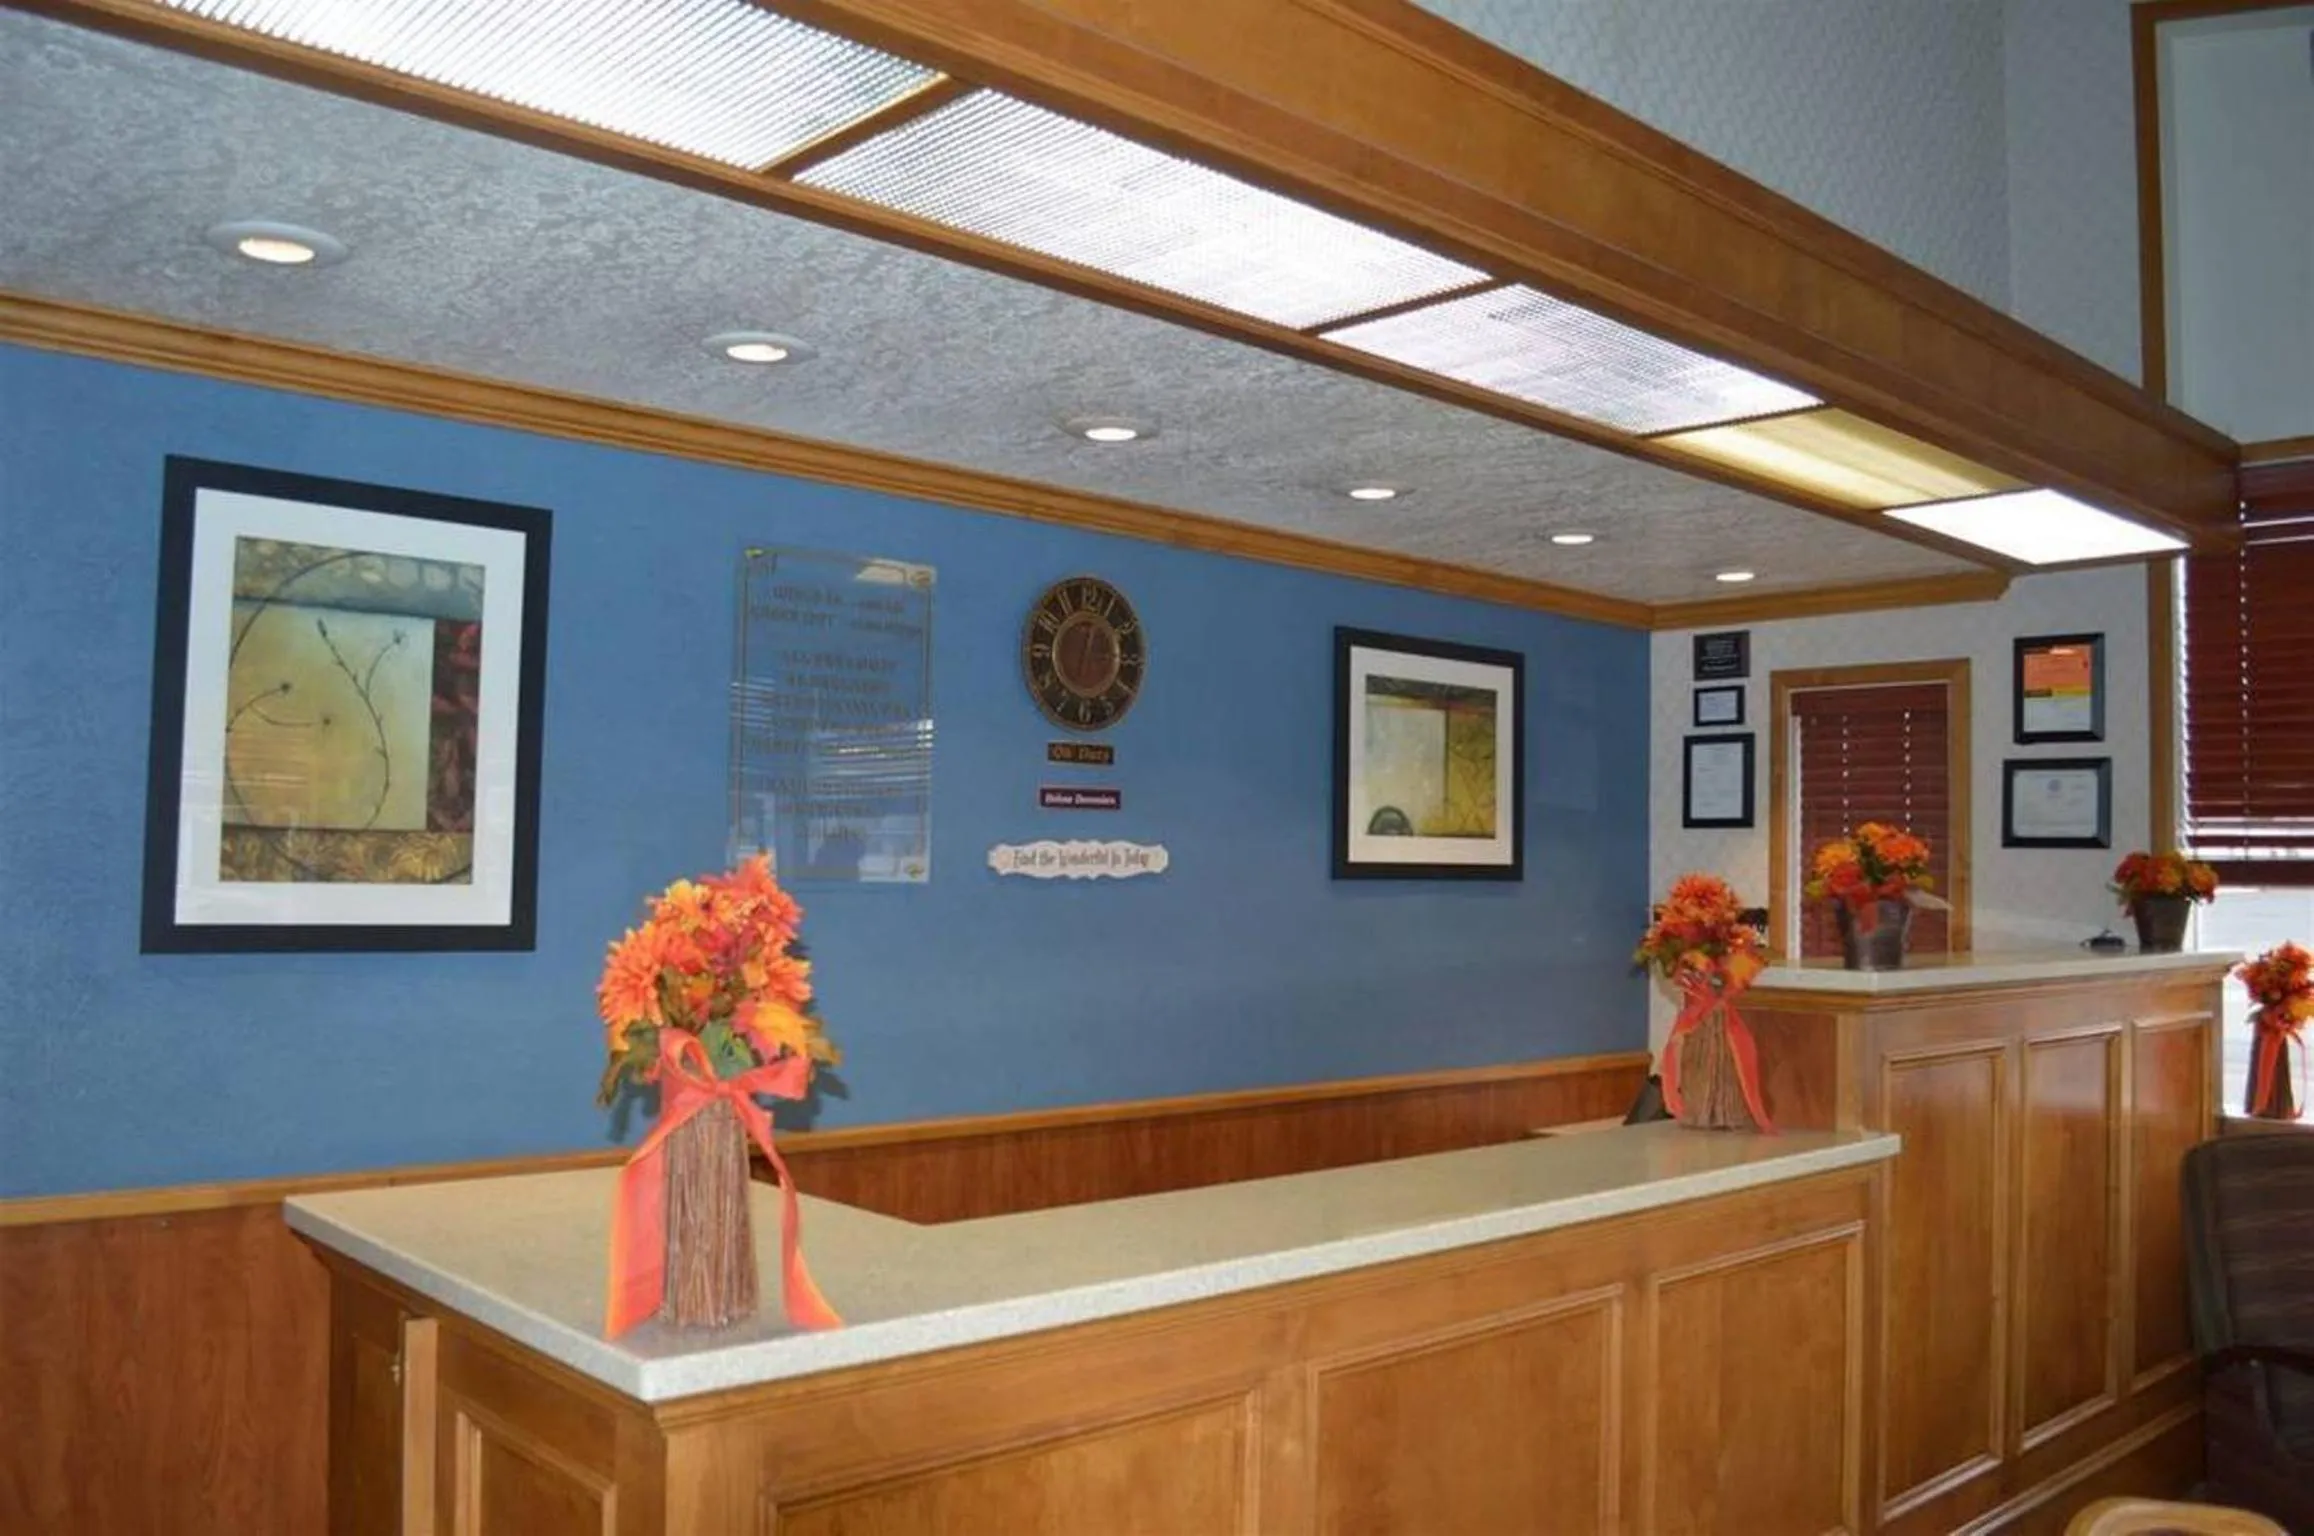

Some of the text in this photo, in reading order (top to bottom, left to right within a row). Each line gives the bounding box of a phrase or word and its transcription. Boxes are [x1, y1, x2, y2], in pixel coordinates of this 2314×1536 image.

[1081, 582, 1101, 615] 12
[1078, 700, 1092, 723] 6
[1013, 850, 1036, 868] Find
[1039, 849, 1056, 866] the
